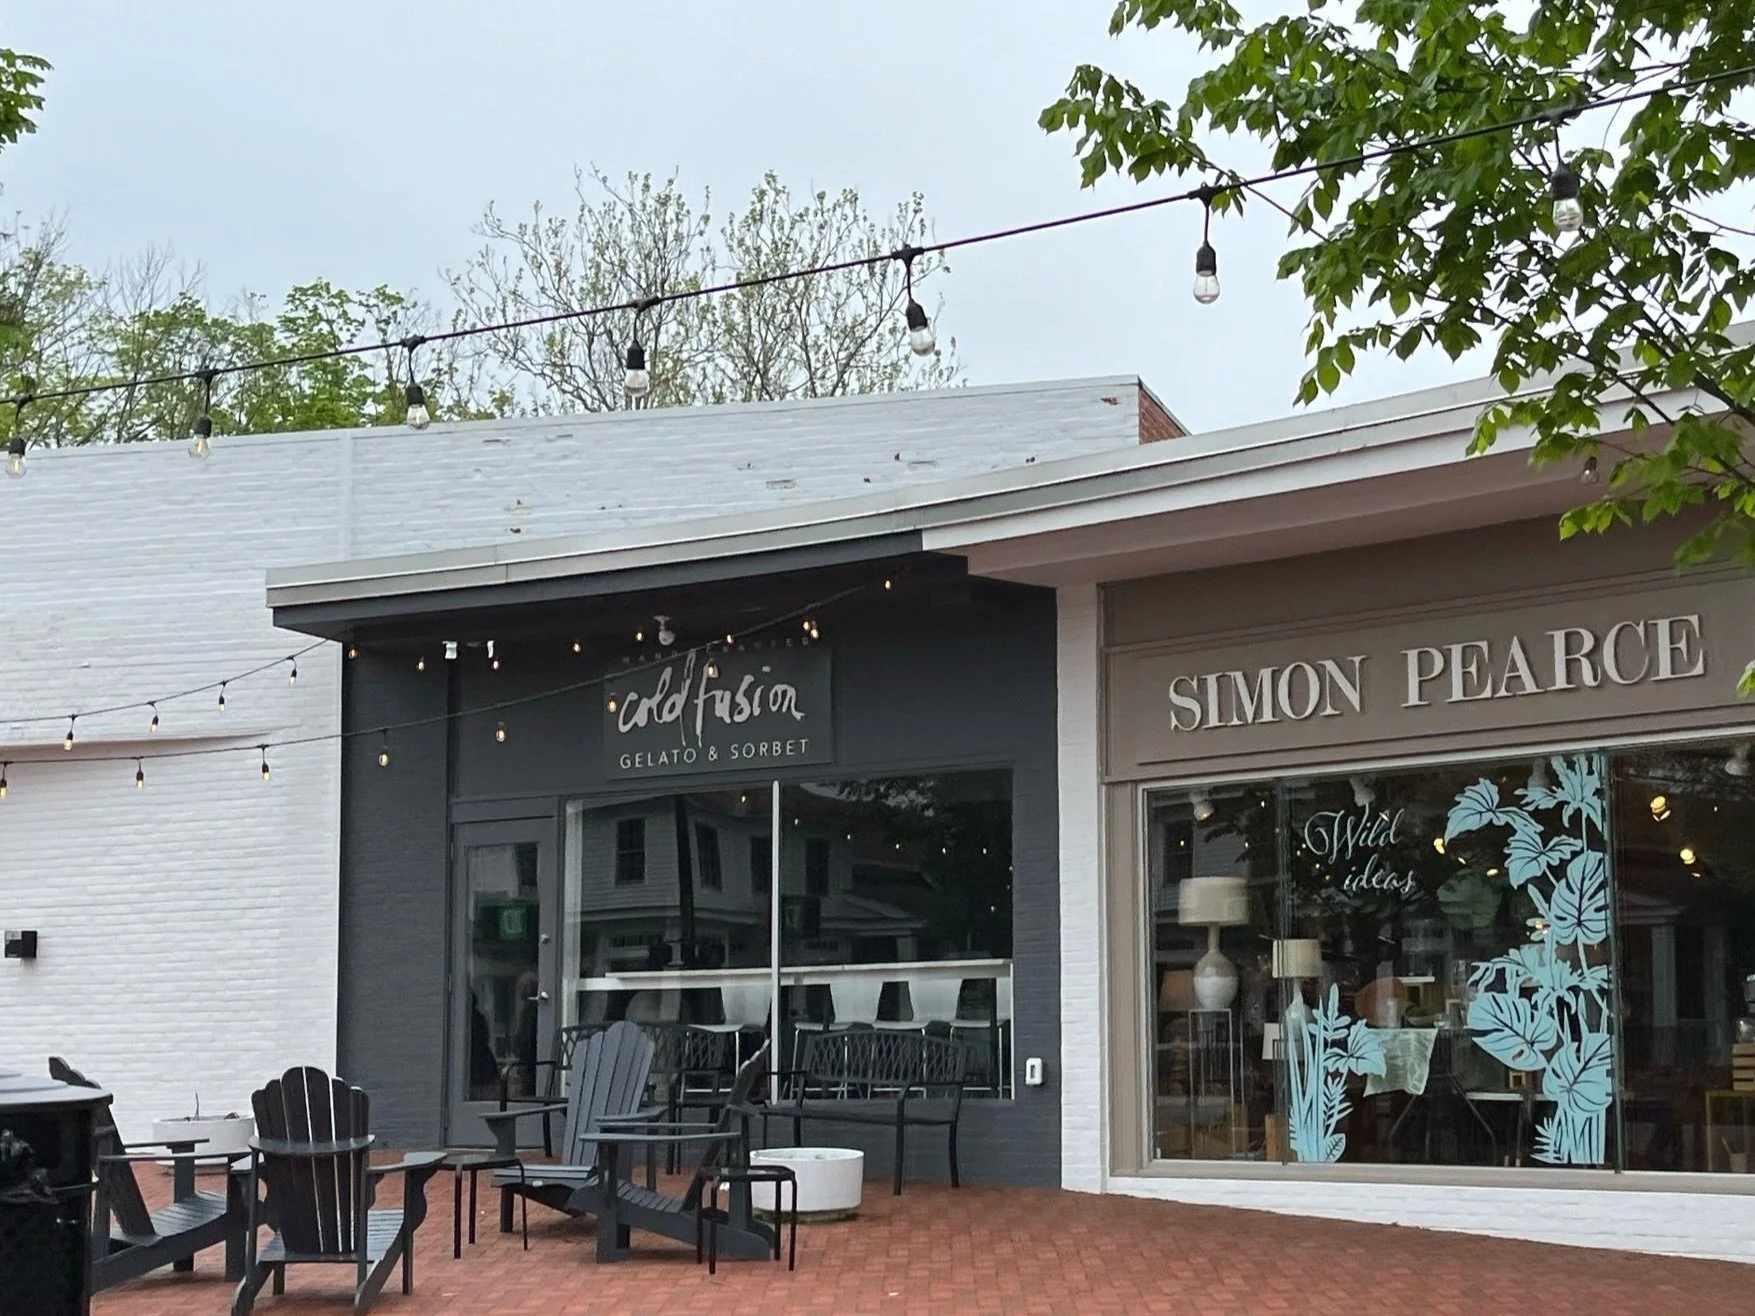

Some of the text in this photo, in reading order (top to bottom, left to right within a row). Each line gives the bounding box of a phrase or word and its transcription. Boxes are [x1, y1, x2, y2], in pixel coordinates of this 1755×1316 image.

[618, 649, 805, 748] cold fusion
[1169, 613, 1706, 732] SIMON PEARCE
[620, 738, 810, 769] GELATO & SORBET
[1304, 803, 1405, 864] Wild
[1344, 853, 1416, 894] ideas
